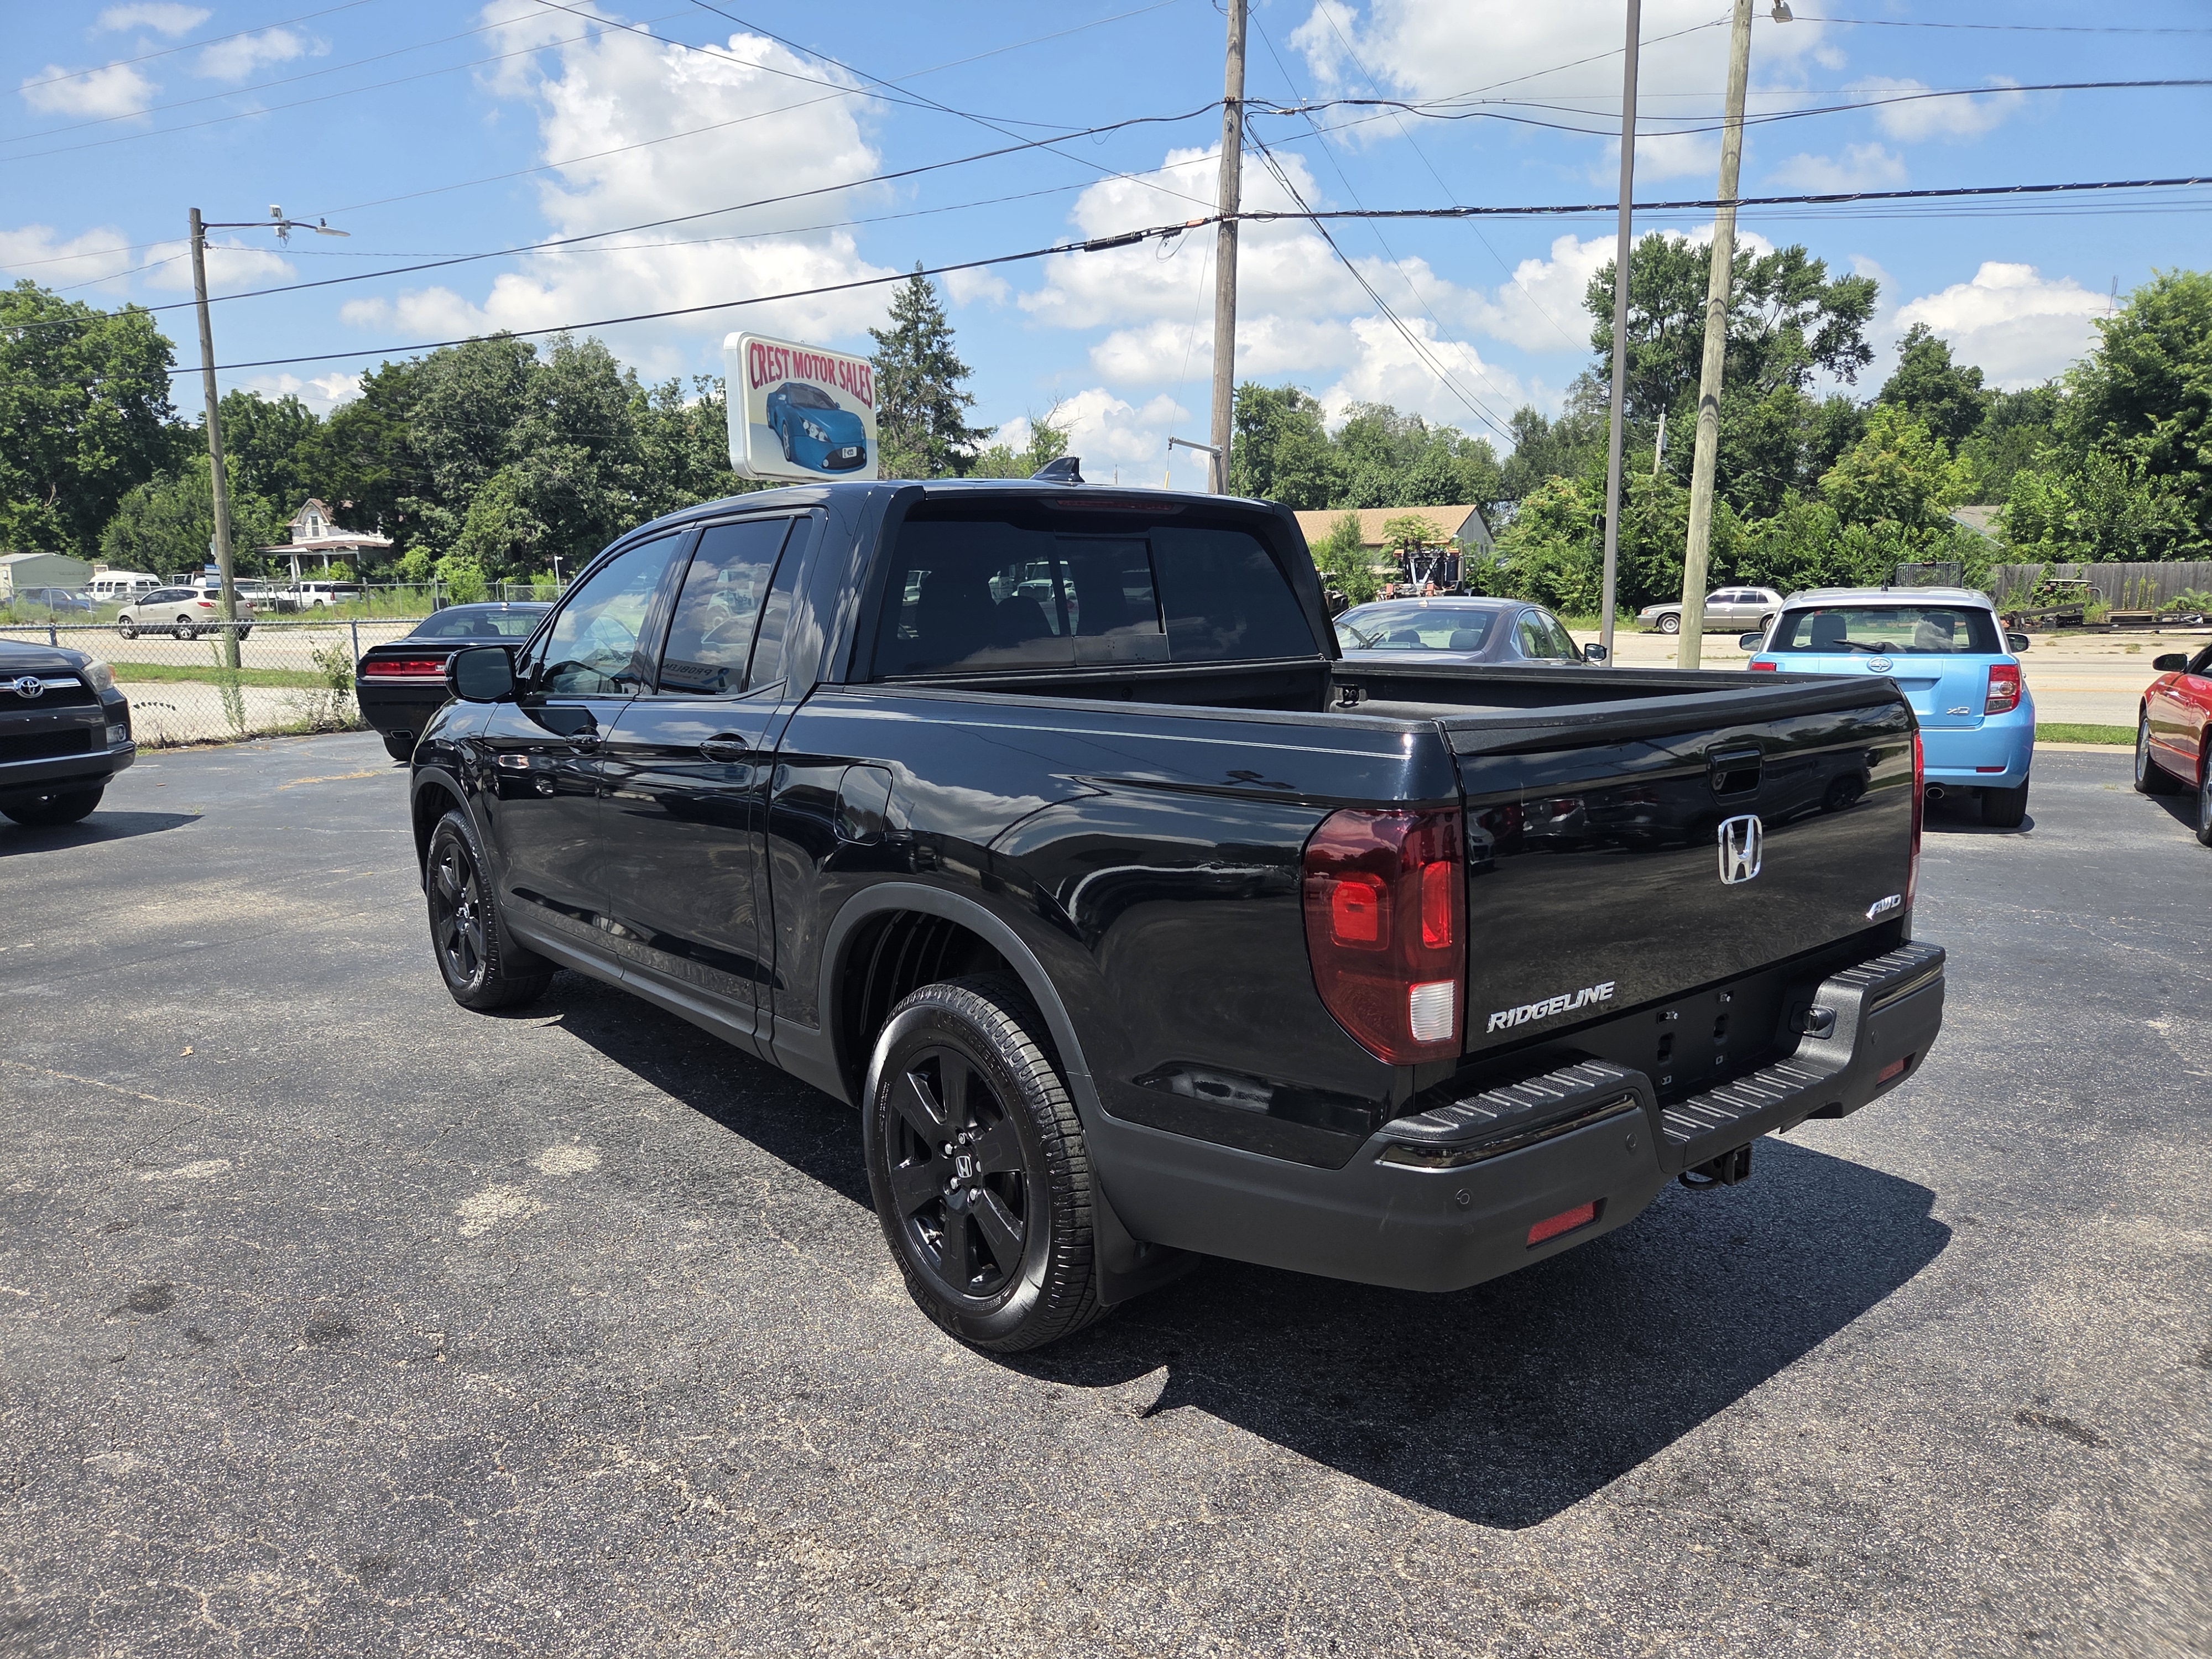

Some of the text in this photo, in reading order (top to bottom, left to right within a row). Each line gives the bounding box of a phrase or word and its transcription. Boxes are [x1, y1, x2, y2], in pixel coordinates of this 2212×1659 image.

[750, 342, 873, 410] CREST MOTOR SALES
[1866, 894, 1901, 920] AWD
[1486, 981, 1615, 1034] RIDGELINE
